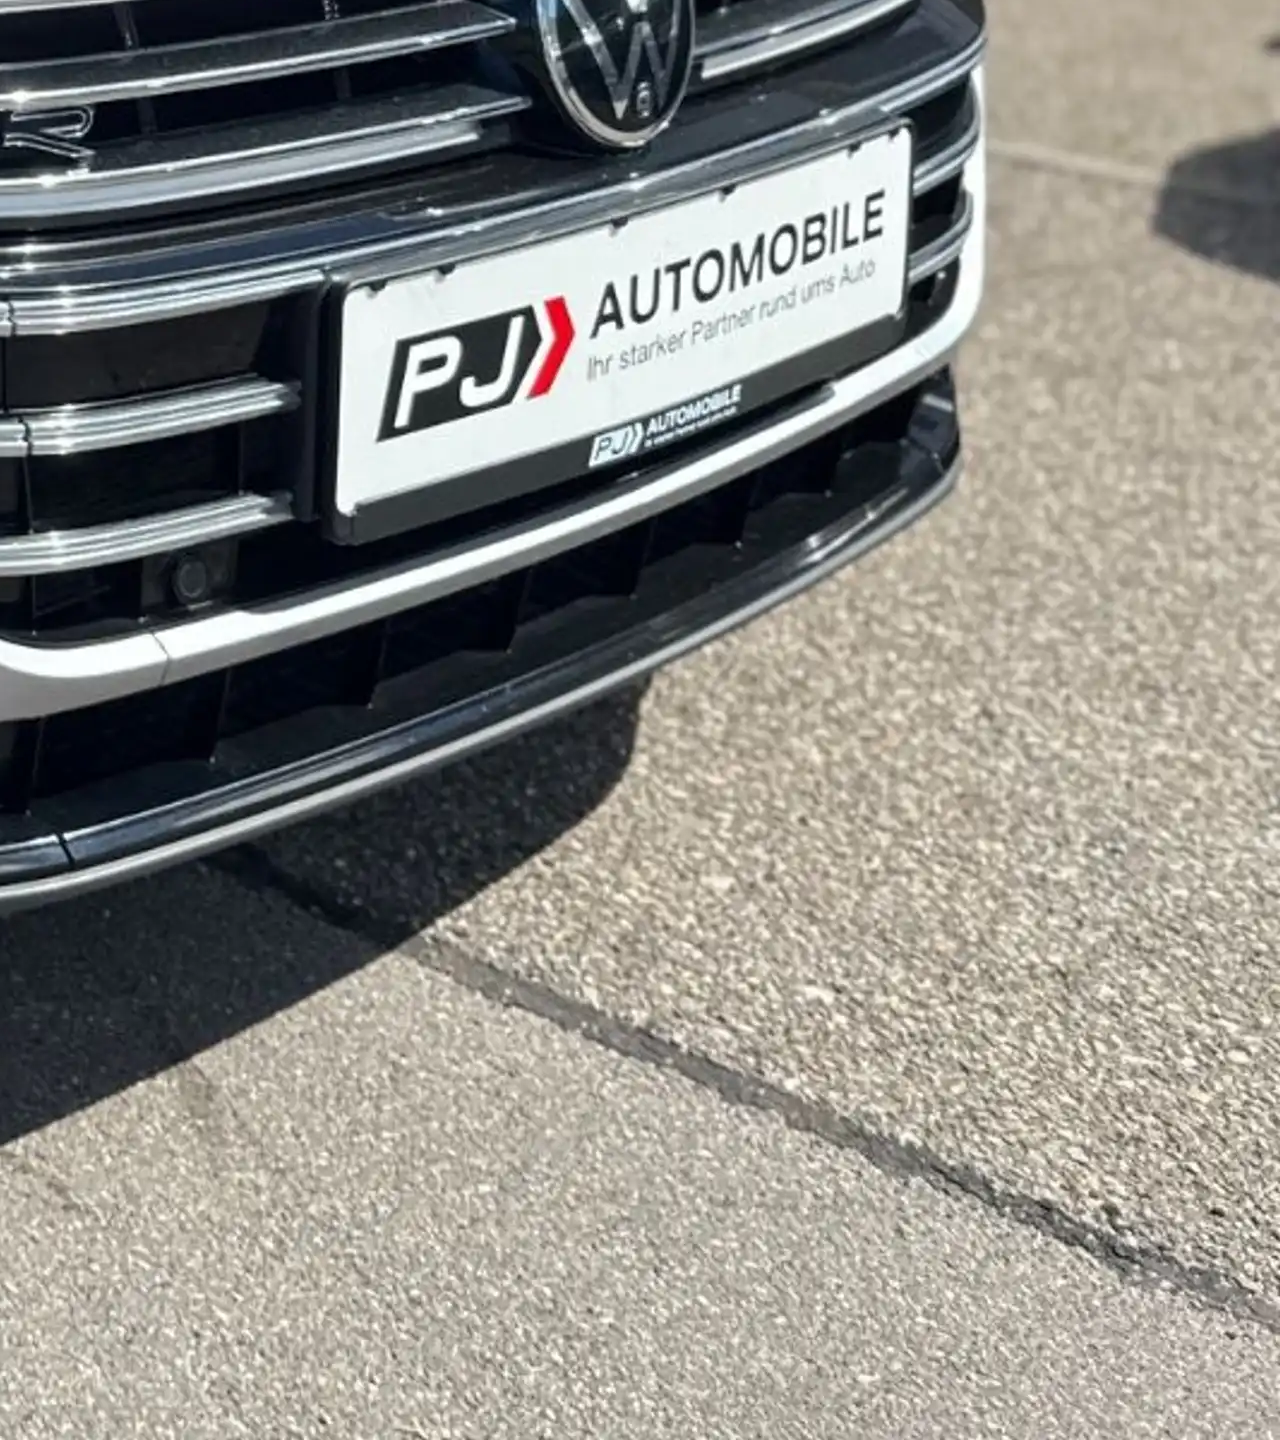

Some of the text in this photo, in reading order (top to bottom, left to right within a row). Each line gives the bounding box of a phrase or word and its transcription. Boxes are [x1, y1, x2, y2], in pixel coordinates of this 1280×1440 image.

[3, 106, 96, 160] R
[393, 188, 886, 429] PJ AUTOMOBILE
[587, 259, 876, 381] Ihr starker Partner rund ums Auto
[593, 428, 631, 462] PJ
[646, 384, 742, 436] AUTOMOBILE
